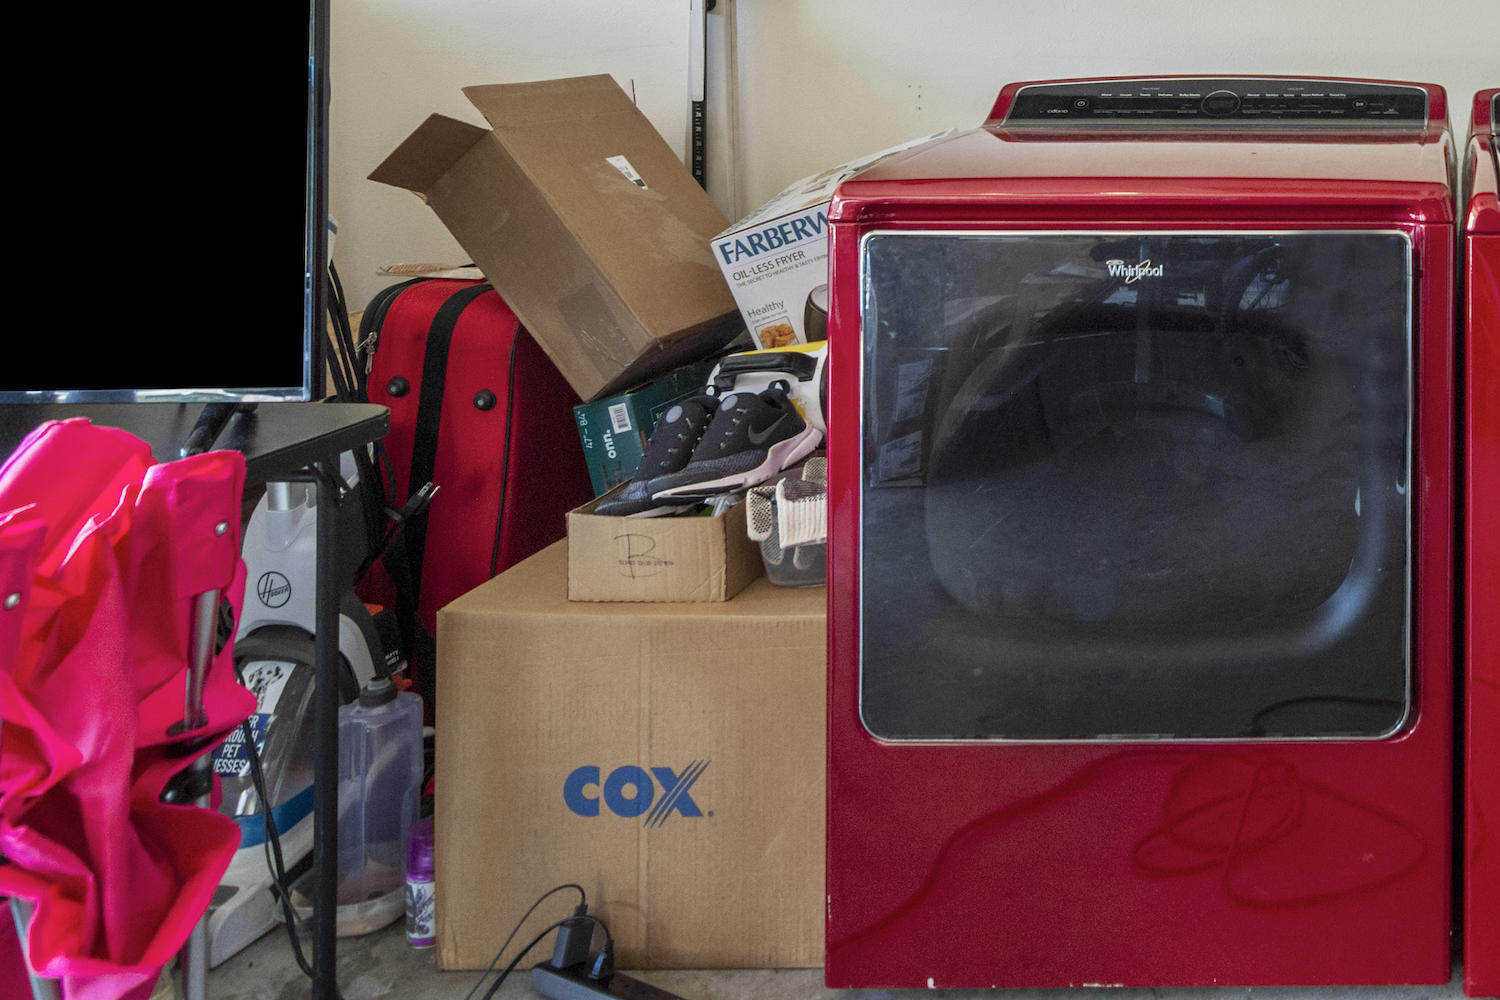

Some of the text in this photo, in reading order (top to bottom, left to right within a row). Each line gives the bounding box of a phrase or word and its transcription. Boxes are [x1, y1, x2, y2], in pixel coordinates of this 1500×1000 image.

[732, 250, 806, 281] OIL-LESS FRYER
[1107, 261, 1163, 281] Whirlpool
[765, 272, 773, 280] TO
[746, 300, 784, 318] Healthy
[221, 743, 241, 758] PET
[564, 760, 711, 828] COX
